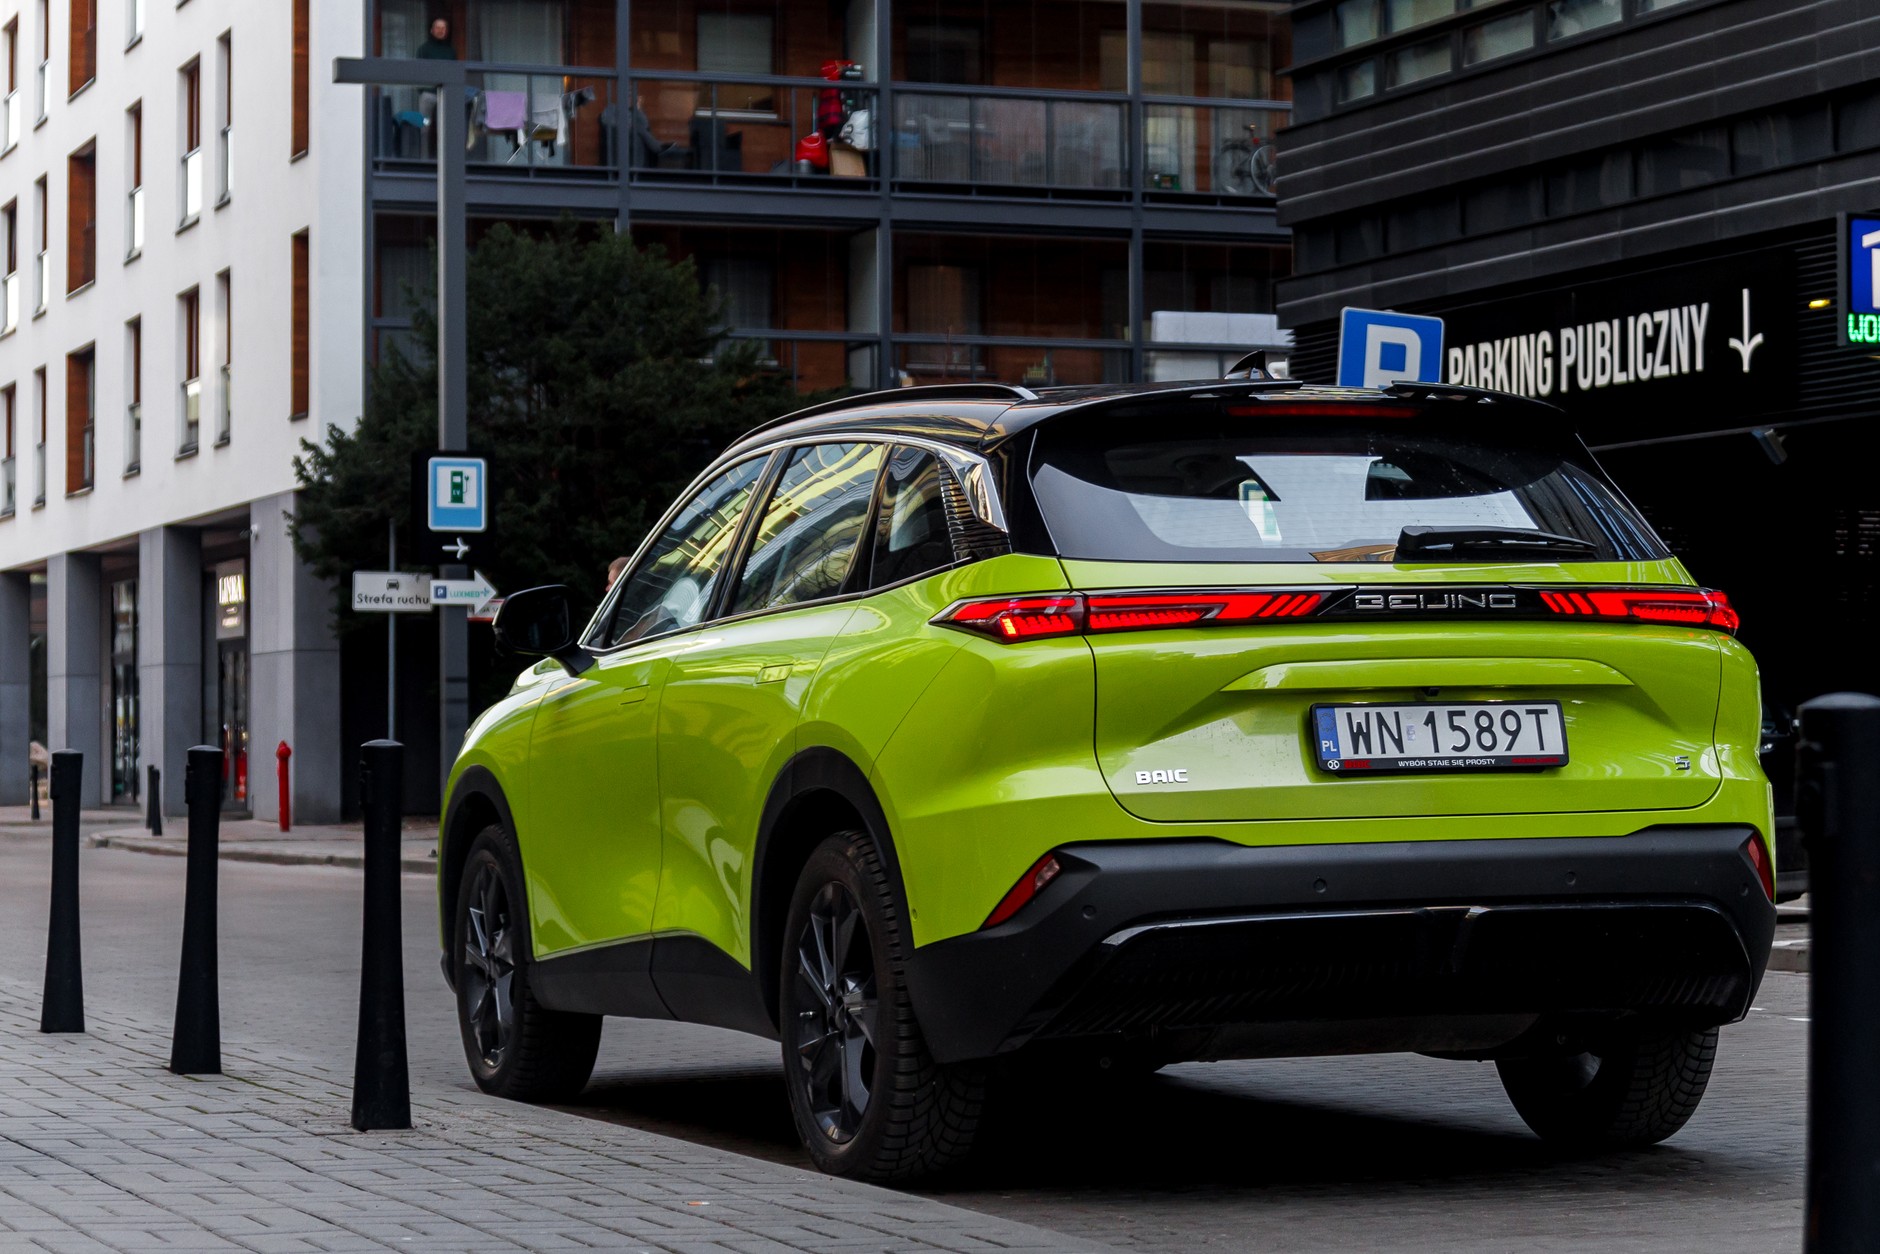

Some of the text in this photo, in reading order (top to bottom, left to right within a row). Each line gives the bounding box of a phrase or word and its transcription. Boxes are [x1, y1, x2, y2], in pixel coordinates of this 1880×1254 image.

[1848, 313, 1880, 343] WO
[1448, 302, 1709, 397] PARKING PUBLICZNY
[356, 593, 429, 604] Strefa ruchu
[1355, 594, 1516, 610] BEIJING
[1346, 708, 1549, 755] WN 1589T
[1321, 740, 1337, 752] PL
[1398, 759, 1426, 767] WYBÓR
[1451, 759, 1464, 767] SIĘ
[1466, 758, 1496, 766] PROSTY
[1135, 769, 1188, 785] BAIC
